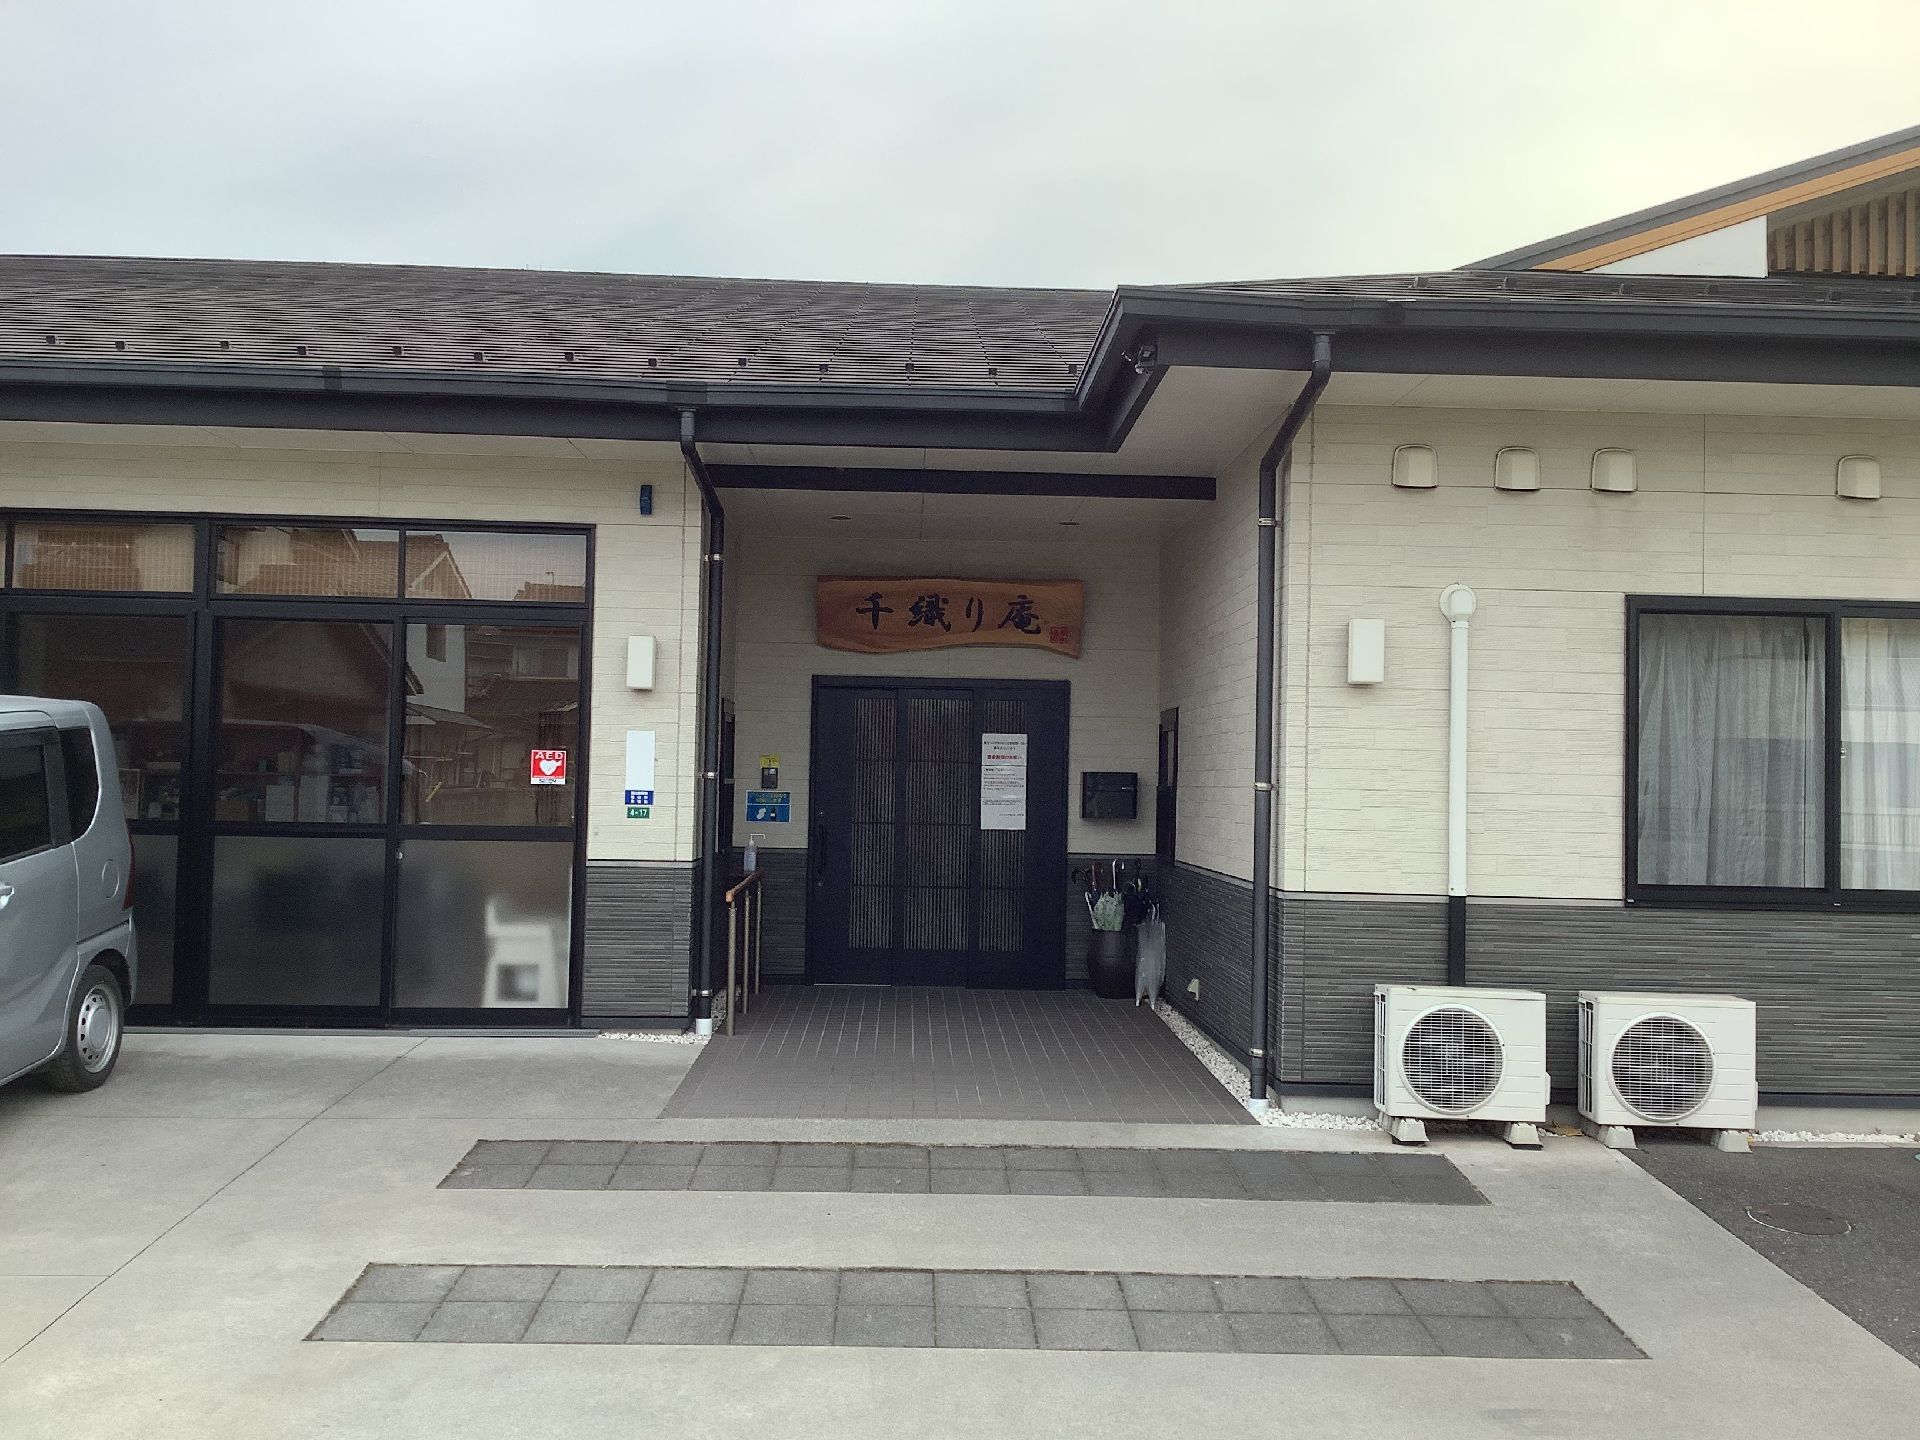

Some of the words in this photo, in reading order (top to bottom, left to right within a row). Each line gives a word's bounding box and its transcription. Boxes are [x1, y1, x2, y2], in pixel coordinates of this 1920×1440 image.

[856, 592, 1042, 635] 千織り庵
[534, 751, 564, 760] AED
[629, 808, 648, 817] 4-17
